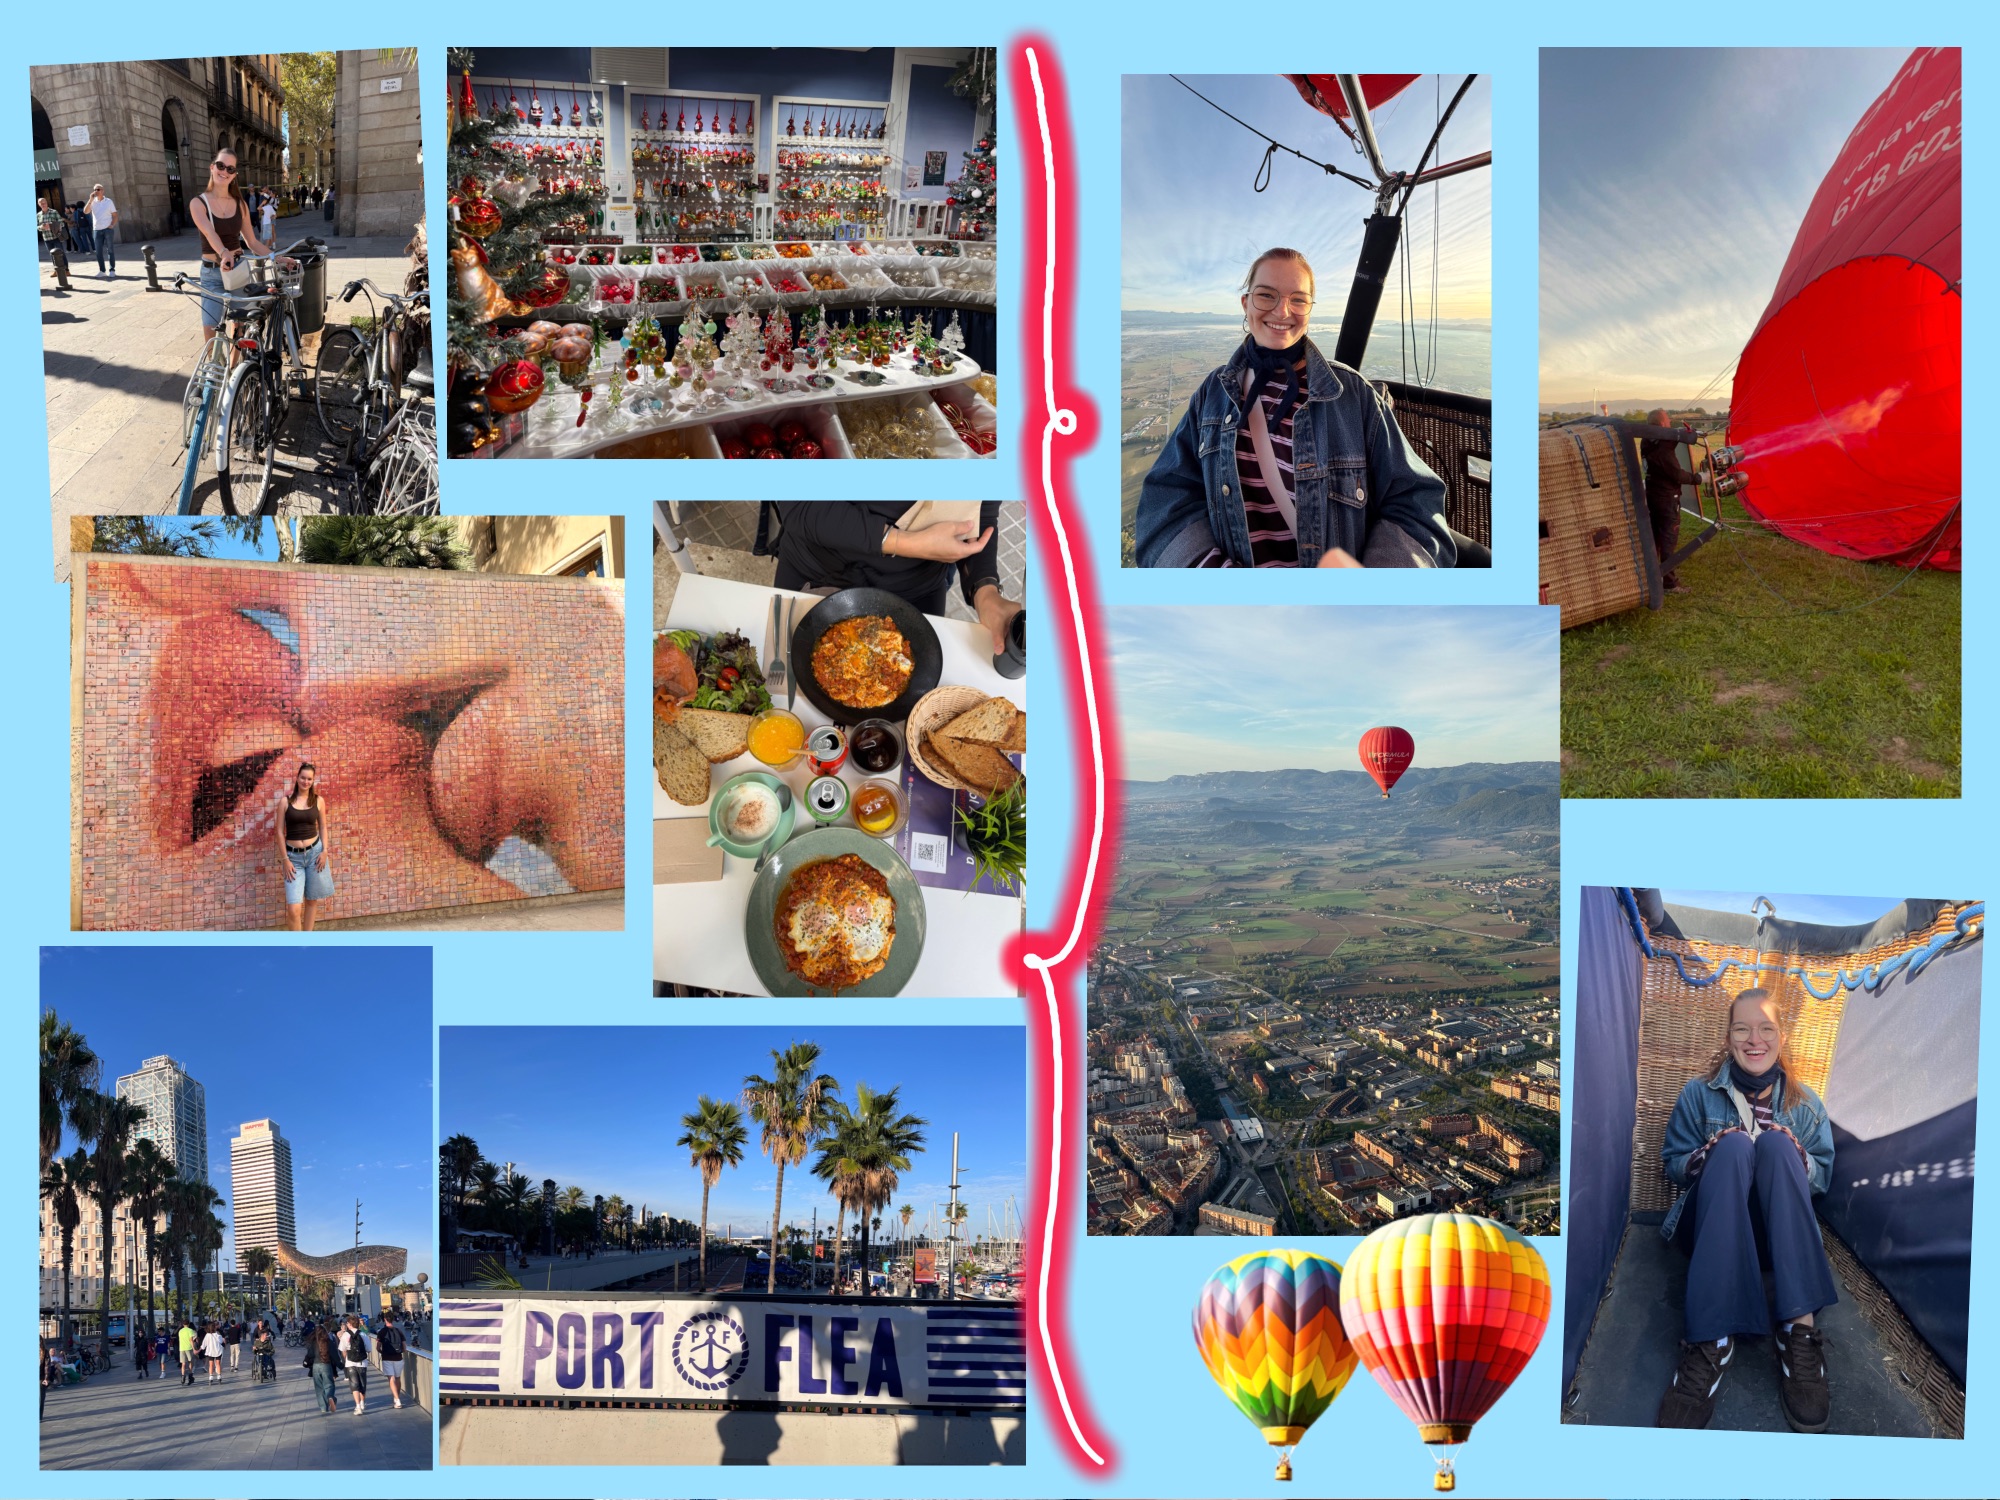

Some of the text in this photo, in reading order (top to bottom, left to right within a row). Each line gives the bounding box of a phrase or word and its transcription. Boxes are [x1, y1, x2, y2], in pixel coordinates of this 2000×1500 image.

[1832, 163, 1891, 227] 678
[522, 1311, 904, 1397] PORT FLEA
[691, 1329, 731, 1344] P F
